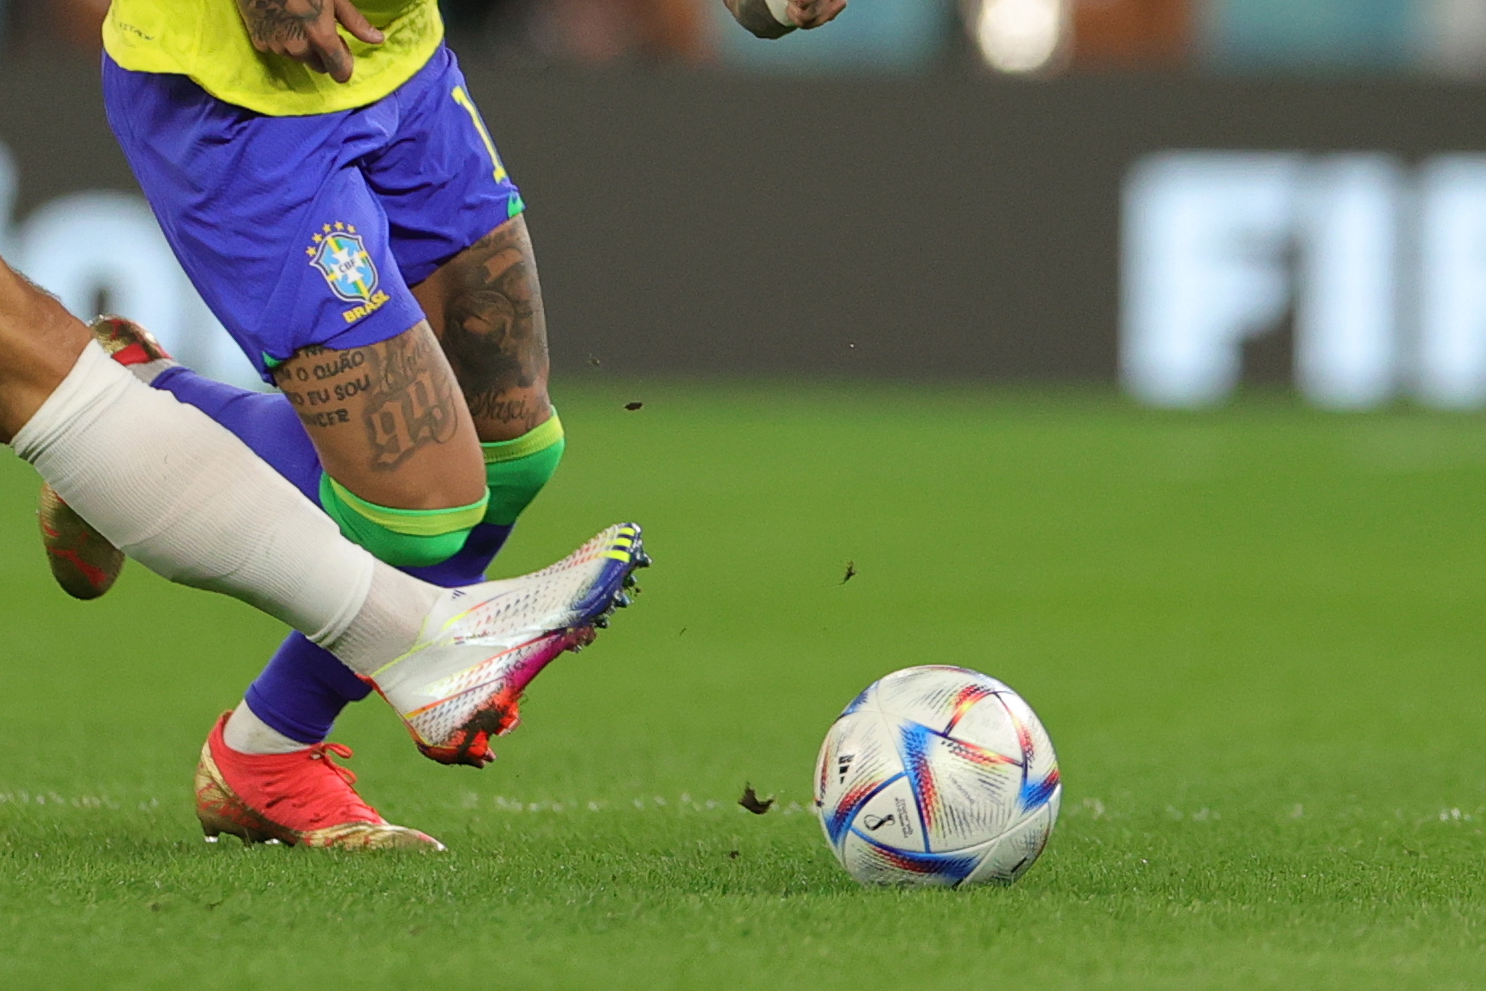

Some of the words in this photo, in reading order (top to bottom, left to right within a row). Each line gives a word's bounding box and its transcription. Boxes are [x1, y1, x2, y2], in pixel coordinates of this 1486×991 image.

[338, 258, 357, 273] CBF
[342, 290, 390, 323] BRASIL
[334, 374, 370, 401] SOU
